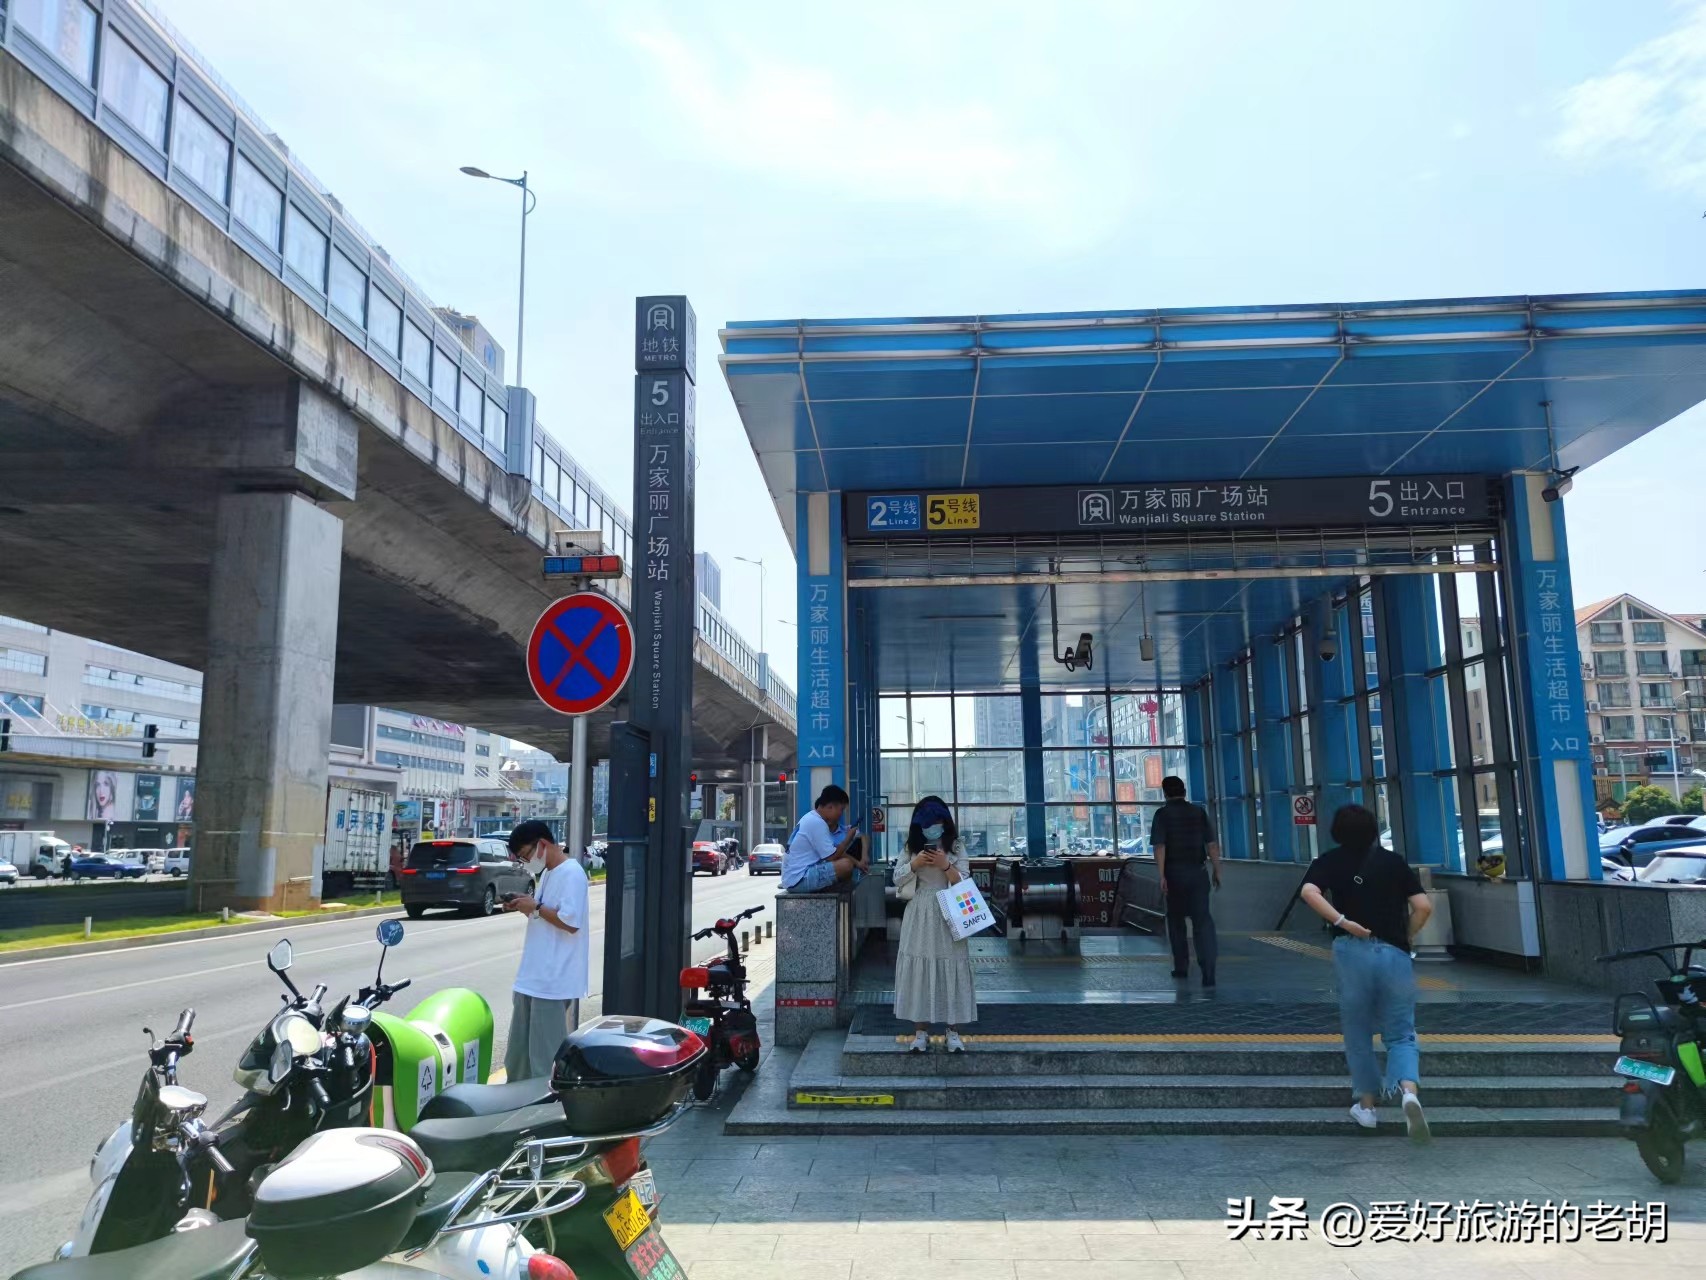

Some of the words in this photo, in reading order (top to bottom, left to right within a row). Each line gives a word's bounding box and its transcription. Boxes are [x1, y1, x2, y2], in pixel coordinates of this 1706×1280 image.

[642, 337, 679, 352] 地铁
[651, 380, 669, 406] 5
[641, 412, 679, 426] 出入口
[640, 427, 679, 435] Entrance
[1120, 484, 1268, 509] 万家丽广场站
[1368, 480, 1394, 517] 5
[1400, 480, 1464, 501] 出入口
[647, 444, 670, 581] 万家丽广场站
[911, 517, 917, 525] 2
[947, 517, 969, 525] Line
[972, 516, 977, 524] 5
[1120, 513, 1169, 525] Wanjiali
[1172, 512, 1217, 524] Square
[1220, 511, 1265, 521] Station
[1401, 506, 1466, 516] Entrance
[652, 590, 663, 631] Wanjiali
[652, 633, 662, 670] Square
[1536, 569, 1571, 723] 万家丽生活超市
[810, 584, 831, 731] 万家丽生活超市
[652, 672, 661, 709] Station
[808, 745, 835, 758] 入口
[1550, 737, 1579, 750] 入口
[962, 913, 987, 929] SANFU
[616, 1202, 633, 1222] 长沙
[617, 1208, 648, 1244] 0150168
